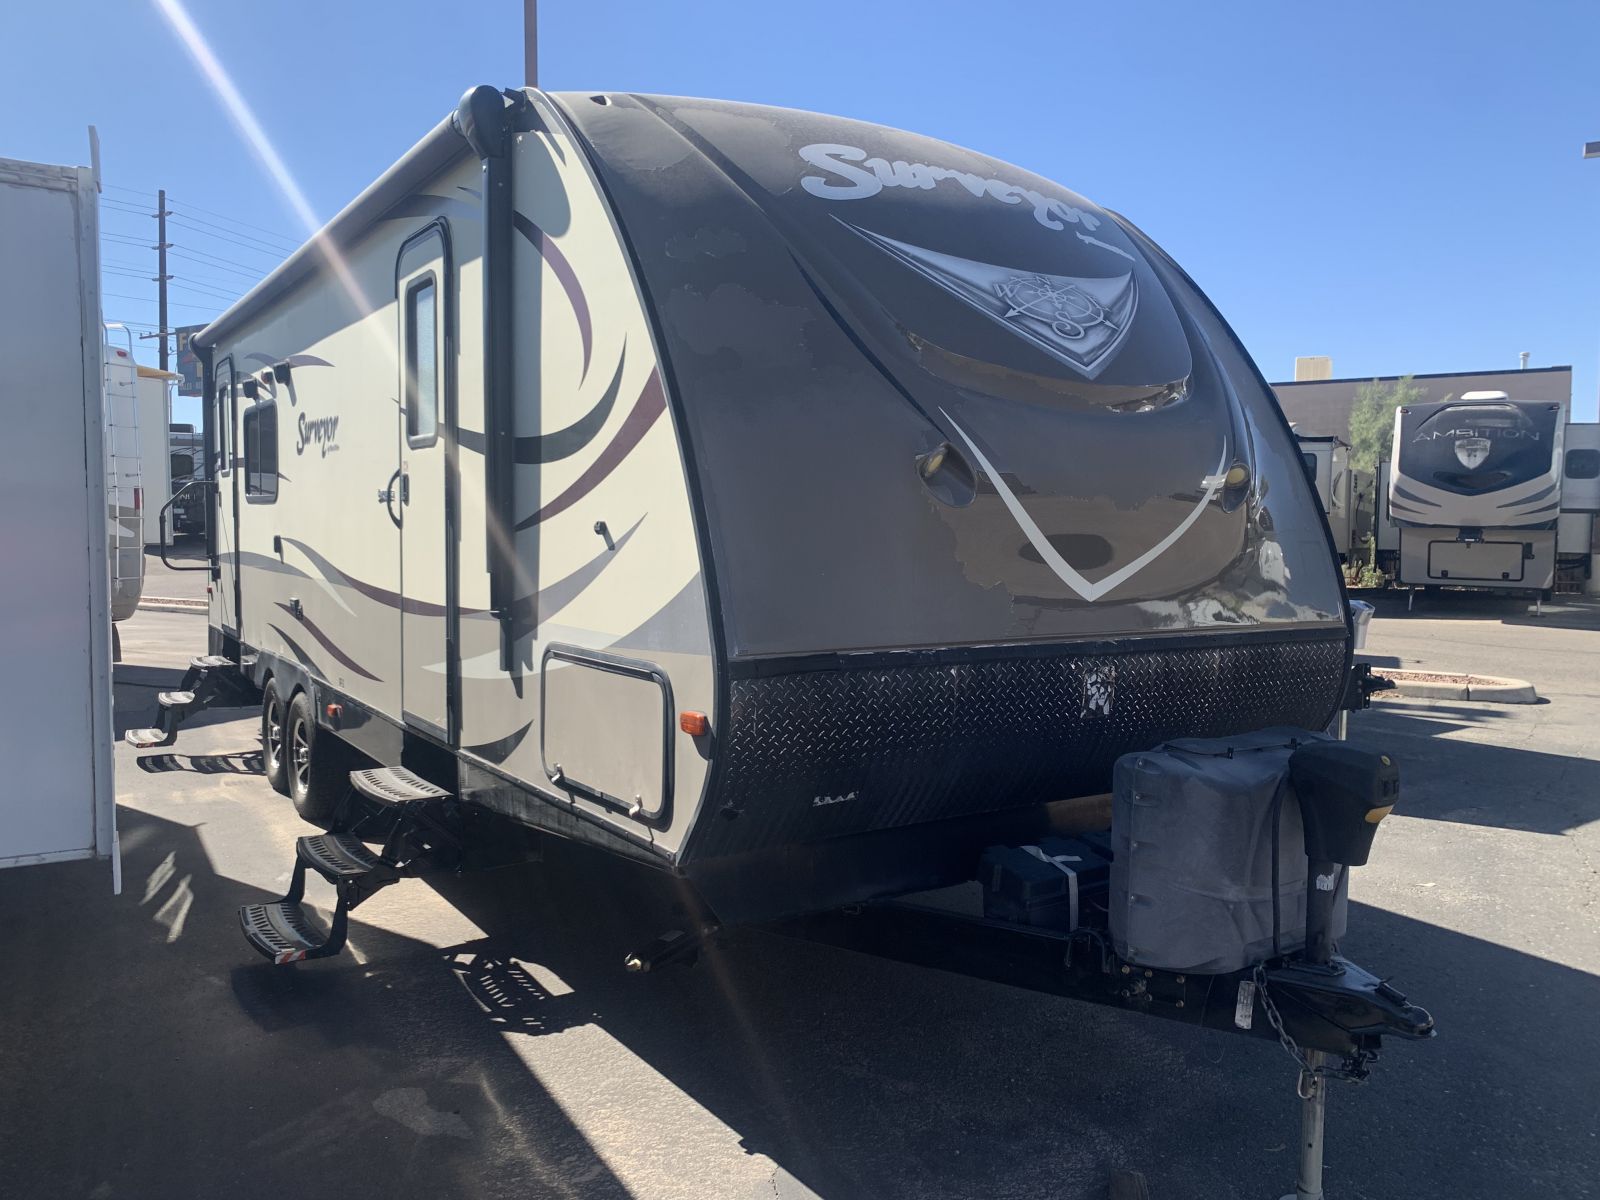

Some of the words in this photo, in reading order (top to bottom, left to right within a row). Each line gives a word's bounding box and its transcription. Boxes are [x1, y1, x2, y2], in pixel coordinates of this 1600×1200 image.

[799, 143, 1101, 231] Surveyor
[296, 411, 339, 459] Surveyor
[1412, 428, 1540, 443] AMBITION
